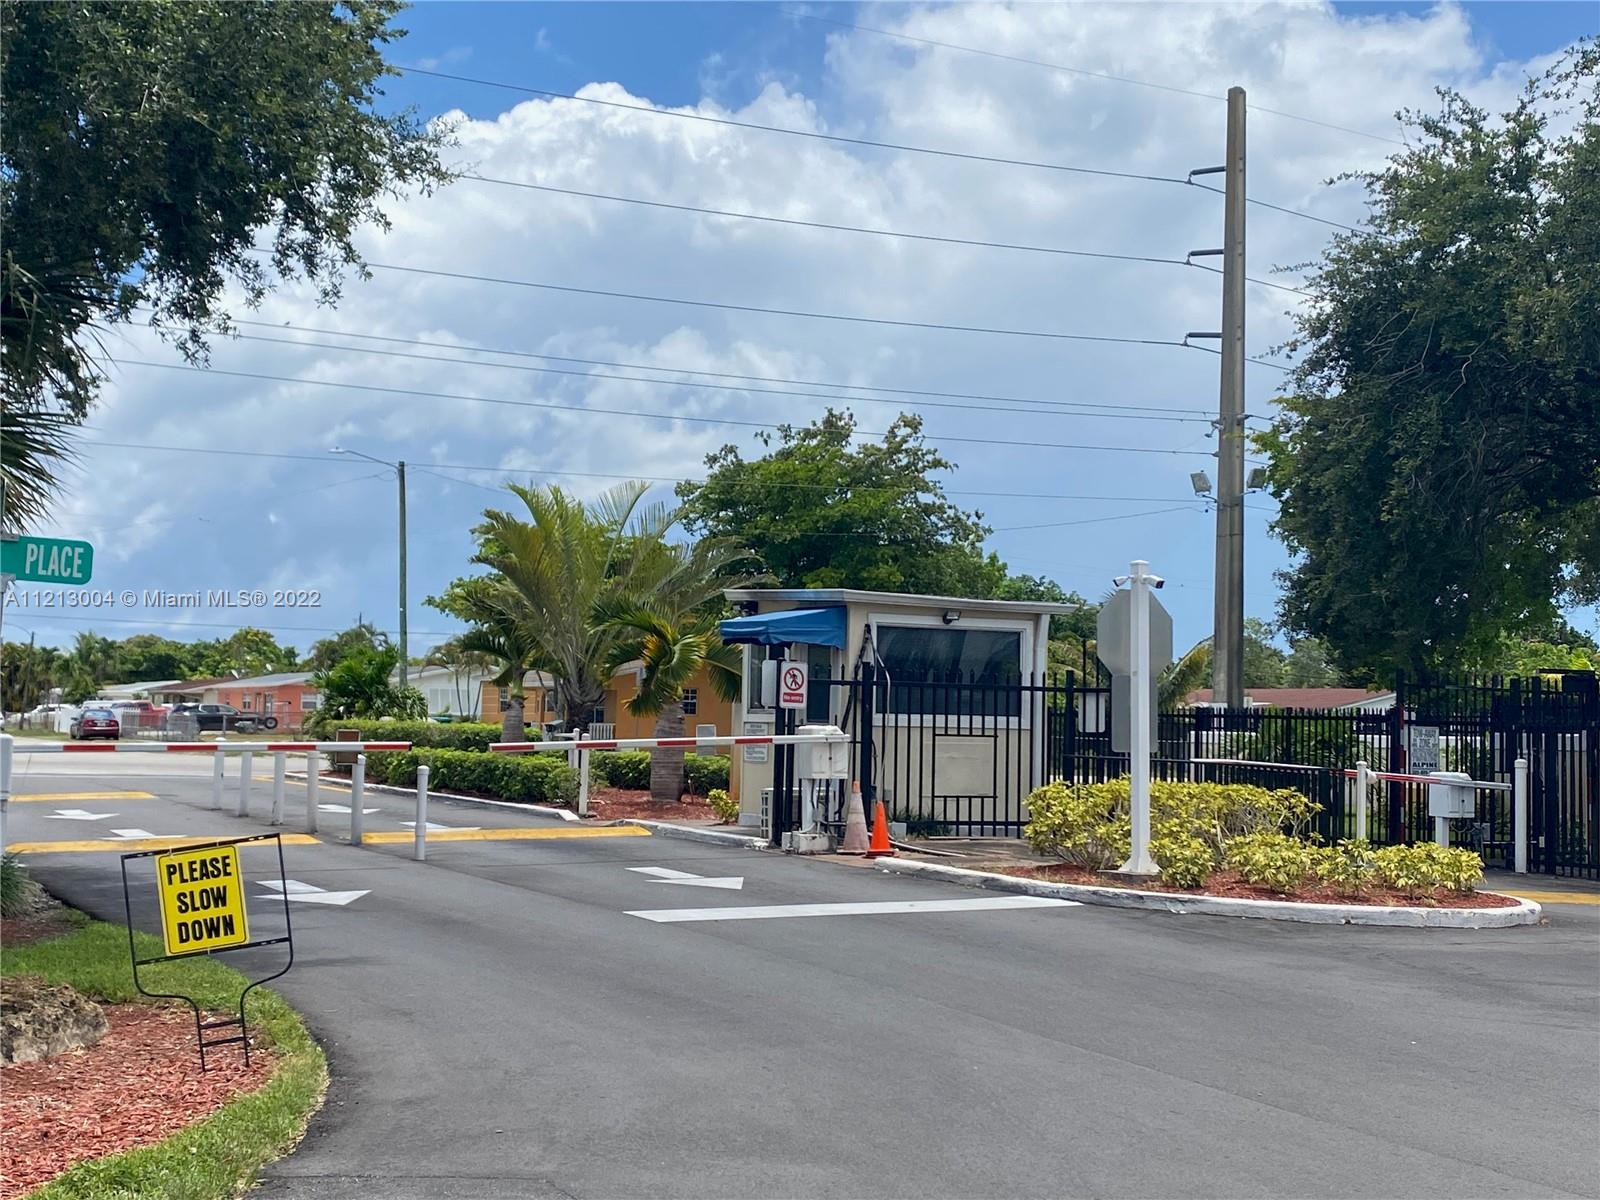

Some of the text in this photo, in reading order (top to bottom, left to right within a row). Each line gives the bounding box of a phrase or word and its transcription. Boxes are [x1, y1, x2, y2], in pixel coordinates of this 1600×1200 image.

[25, 543, 84, 578] PLACE
[165, 855, 232, 886] PLEASE
[176, 885, 227, 914] SLOW
[177, 914, 235, 944] DOWN
